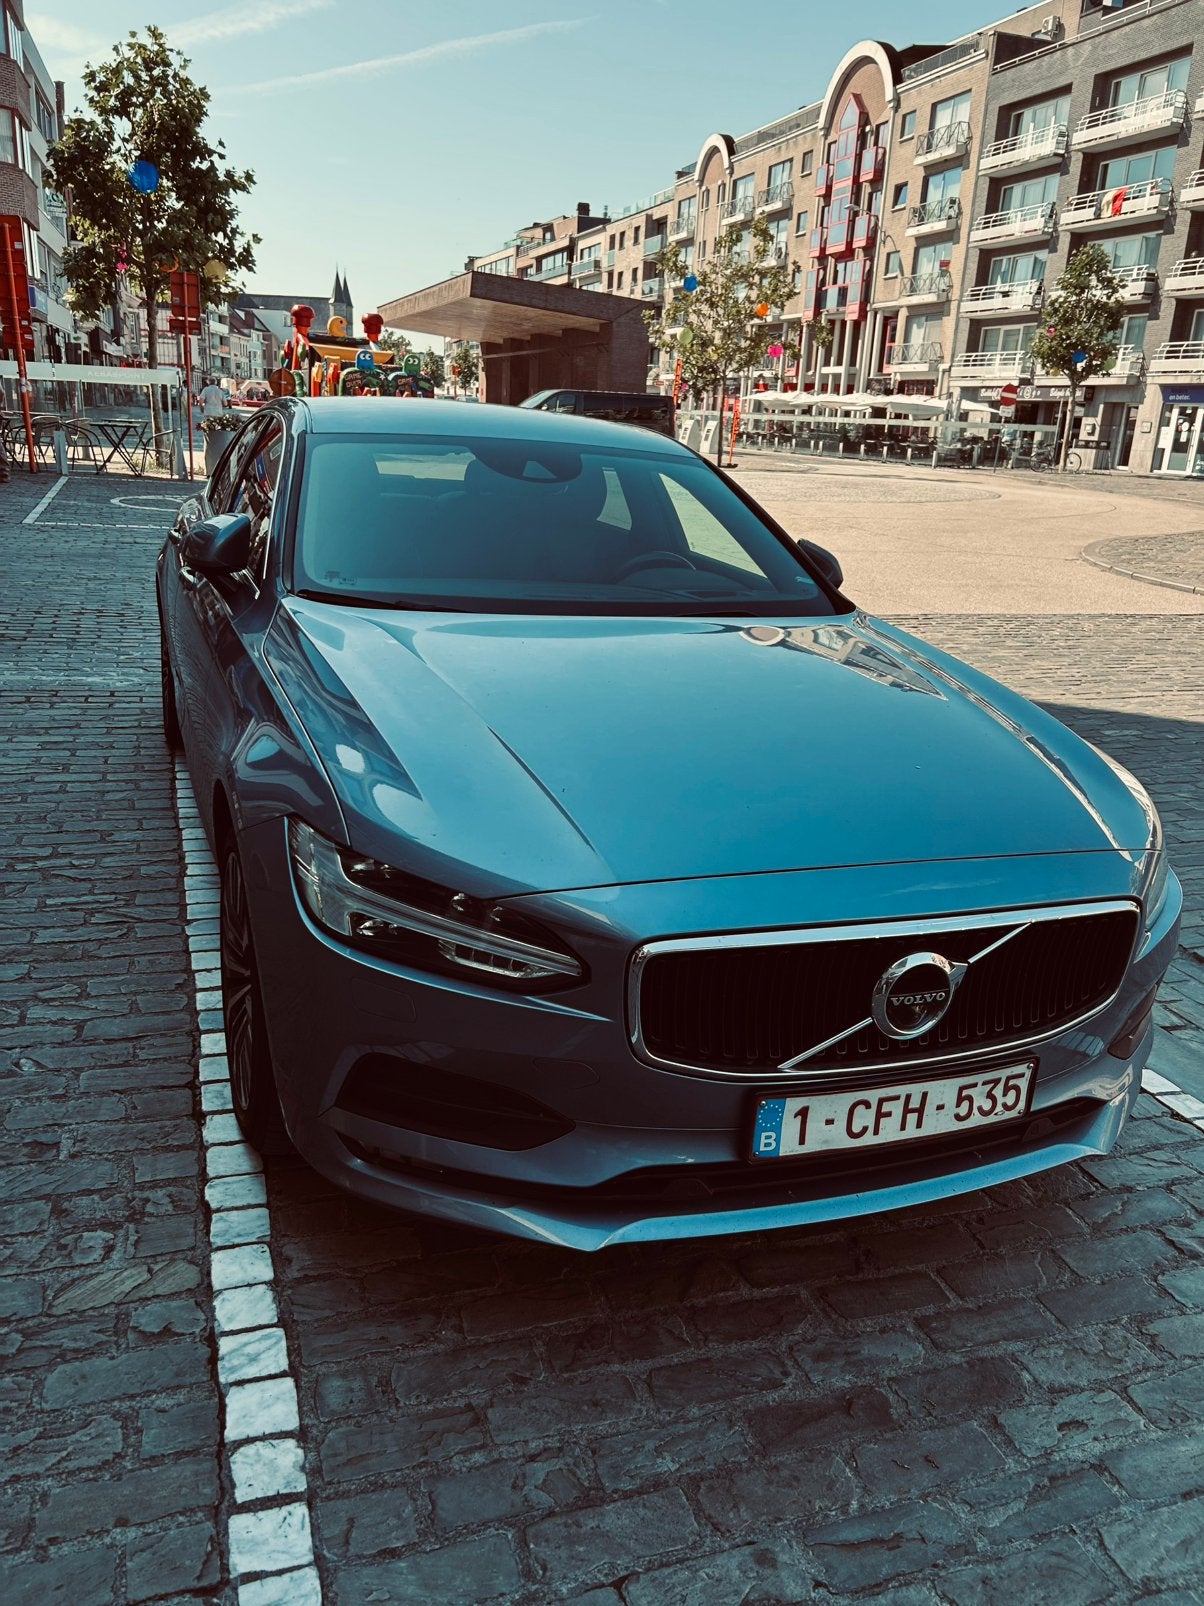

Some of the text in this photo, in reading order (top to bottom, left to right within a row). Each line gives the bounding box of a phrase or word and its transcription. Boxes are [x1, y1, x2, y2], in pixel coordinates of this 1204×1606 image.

[890, 992, 946, 1006] VOLVO
[793, 1072, 1026, 1145] 1-CFH-535
[759, 1132, 777, 1151] B
